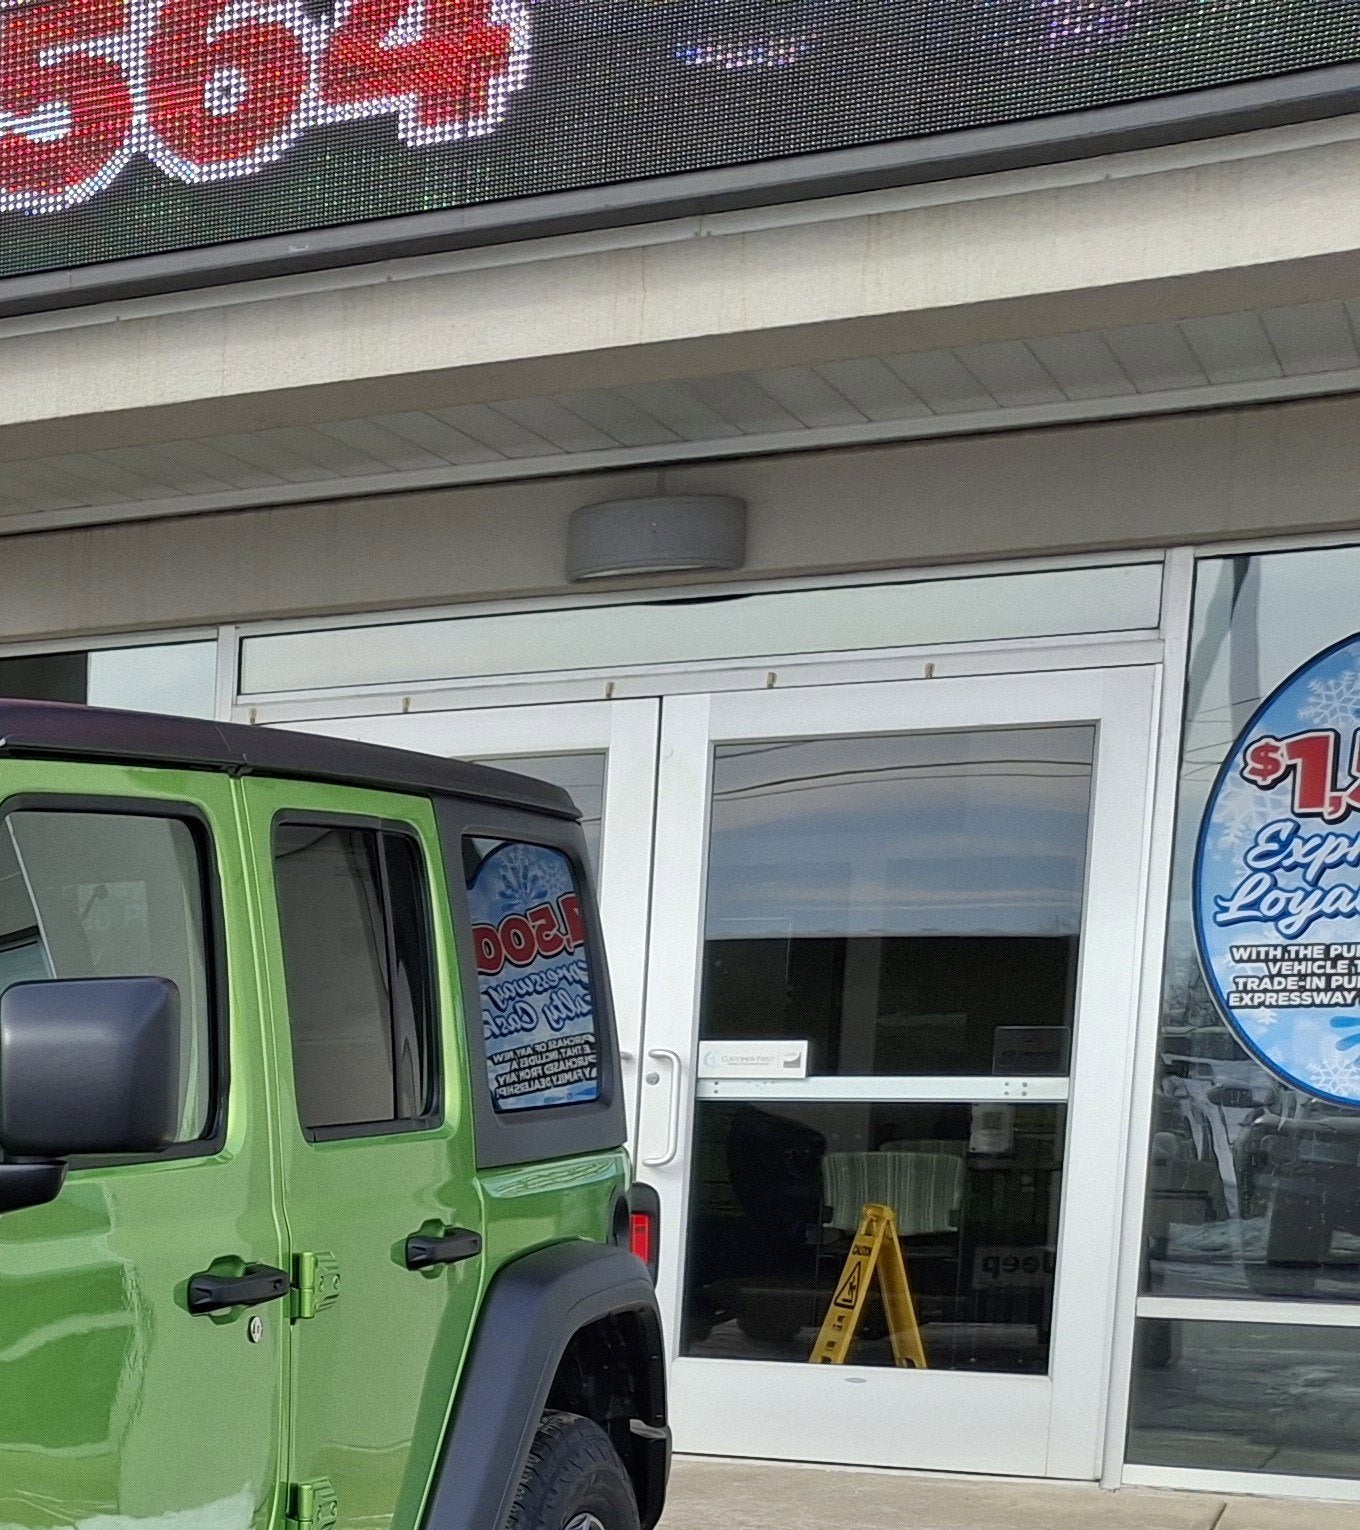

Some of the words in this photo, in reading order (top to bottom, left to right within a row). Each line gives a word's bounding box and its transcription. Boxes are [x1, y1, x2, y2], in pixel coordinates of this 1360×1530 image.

[1240, 728, 1360, 825] $1,
[1213, 871, 1360, 940] Loya
[1231, 946, 1282, 960] WITH
[1287, 945, 1325, 959] THE
[1330, 944, 1360, 958] PU
[1268, 960, 1349, 974] VEHICLE
[1235, 976, 1325, 991] TRADE-IN
[1330, 975, 1360, 989] PU
[1228, 991, 1356, 1006] EXPRESSWAY
